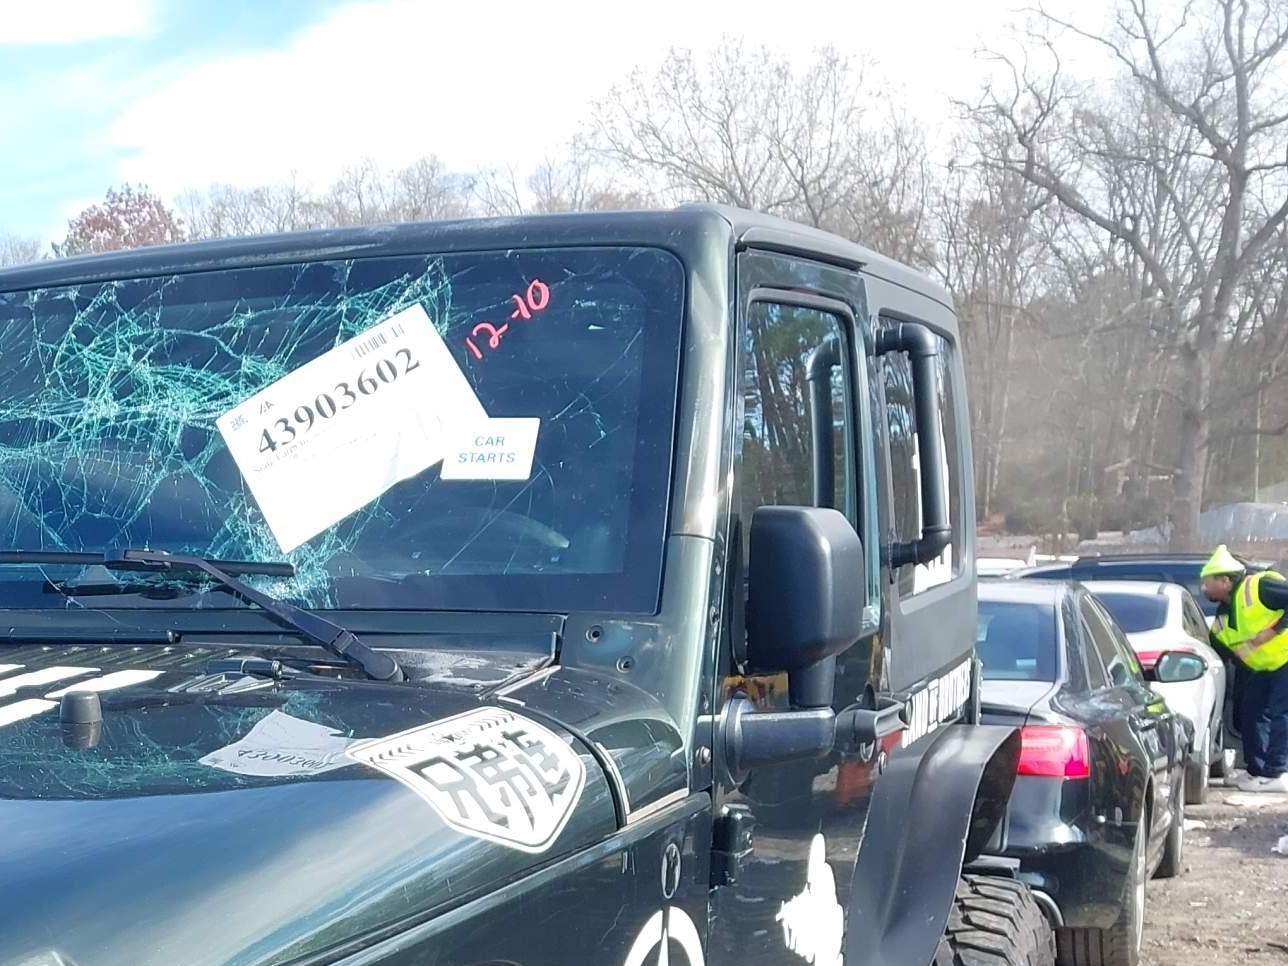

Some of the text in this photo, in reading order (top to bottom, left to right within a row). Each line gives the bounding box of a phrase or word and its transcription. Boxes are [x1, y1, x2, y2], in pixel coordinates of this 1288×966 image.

[466, 279, 550, 359] 12-10
[258, 348, 421, 454] 43903602
[457, 451, 516, 464] STARTS
[474, 435, 505, 447] CAR
